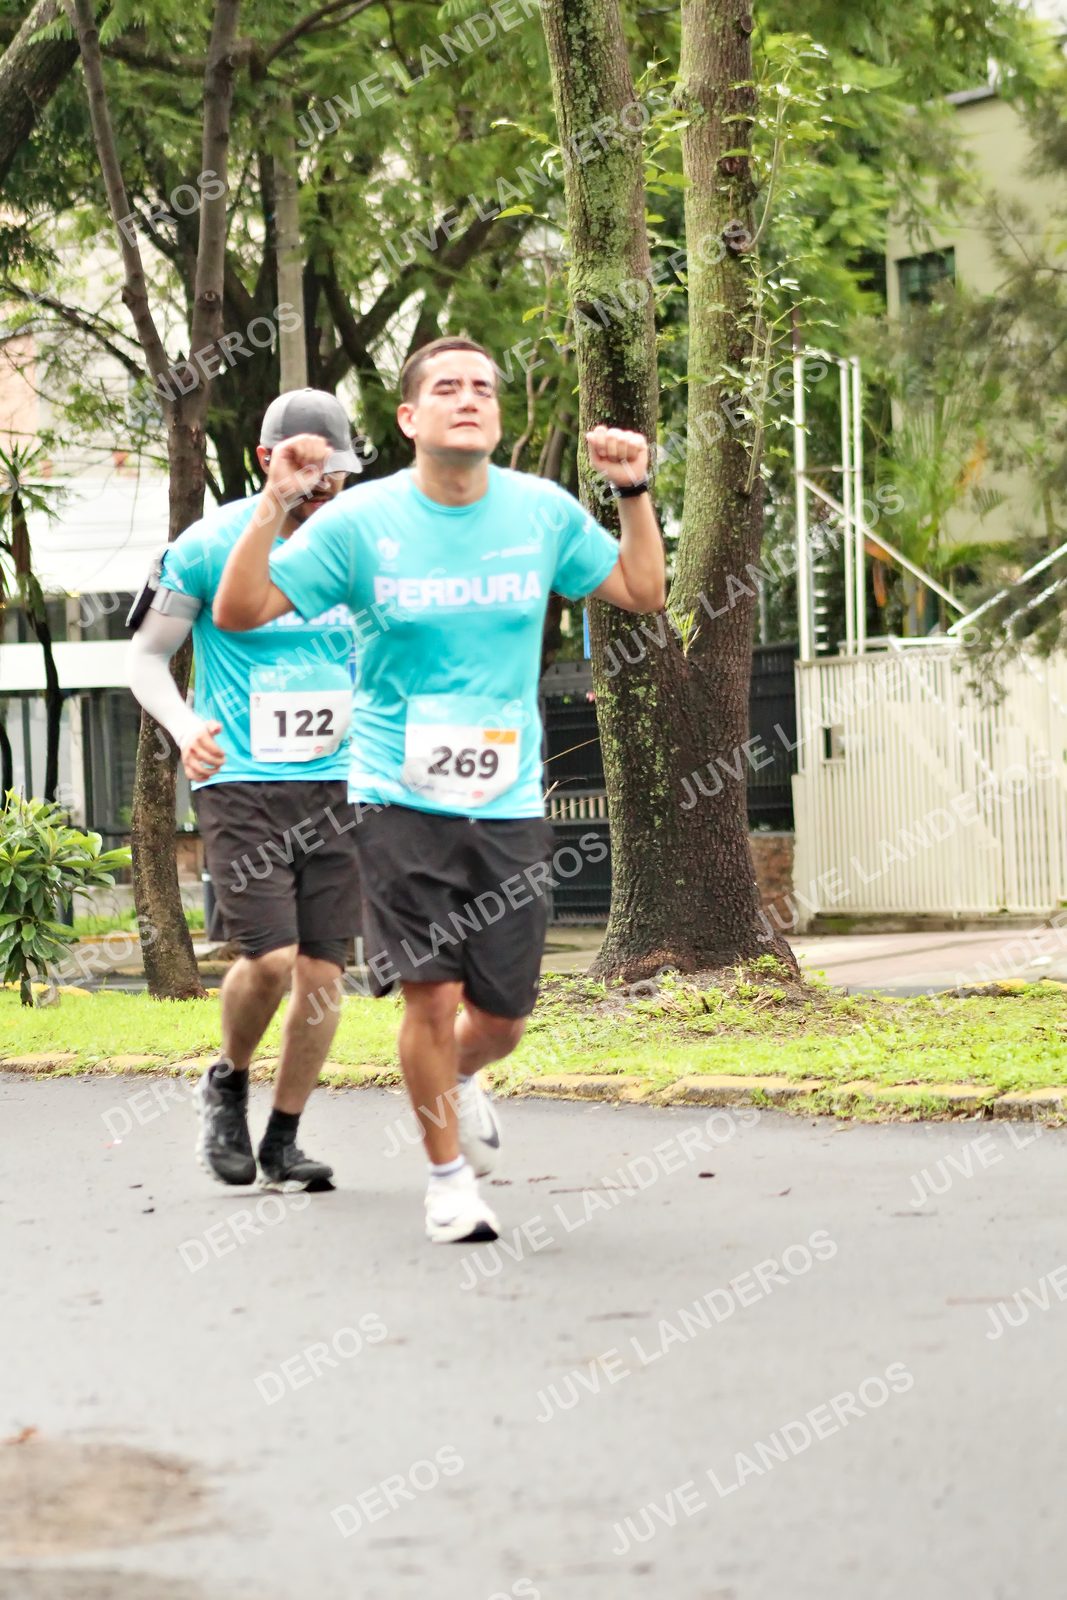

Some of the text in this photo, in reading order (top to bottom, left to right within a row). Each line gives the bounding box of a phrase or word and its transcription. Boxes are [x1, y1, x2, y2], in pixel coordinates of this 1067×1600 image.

[373, 571, 542, 608] PERDURA
[273, 709, 334, 738] 122
[427, 746, 499, 780] 269
